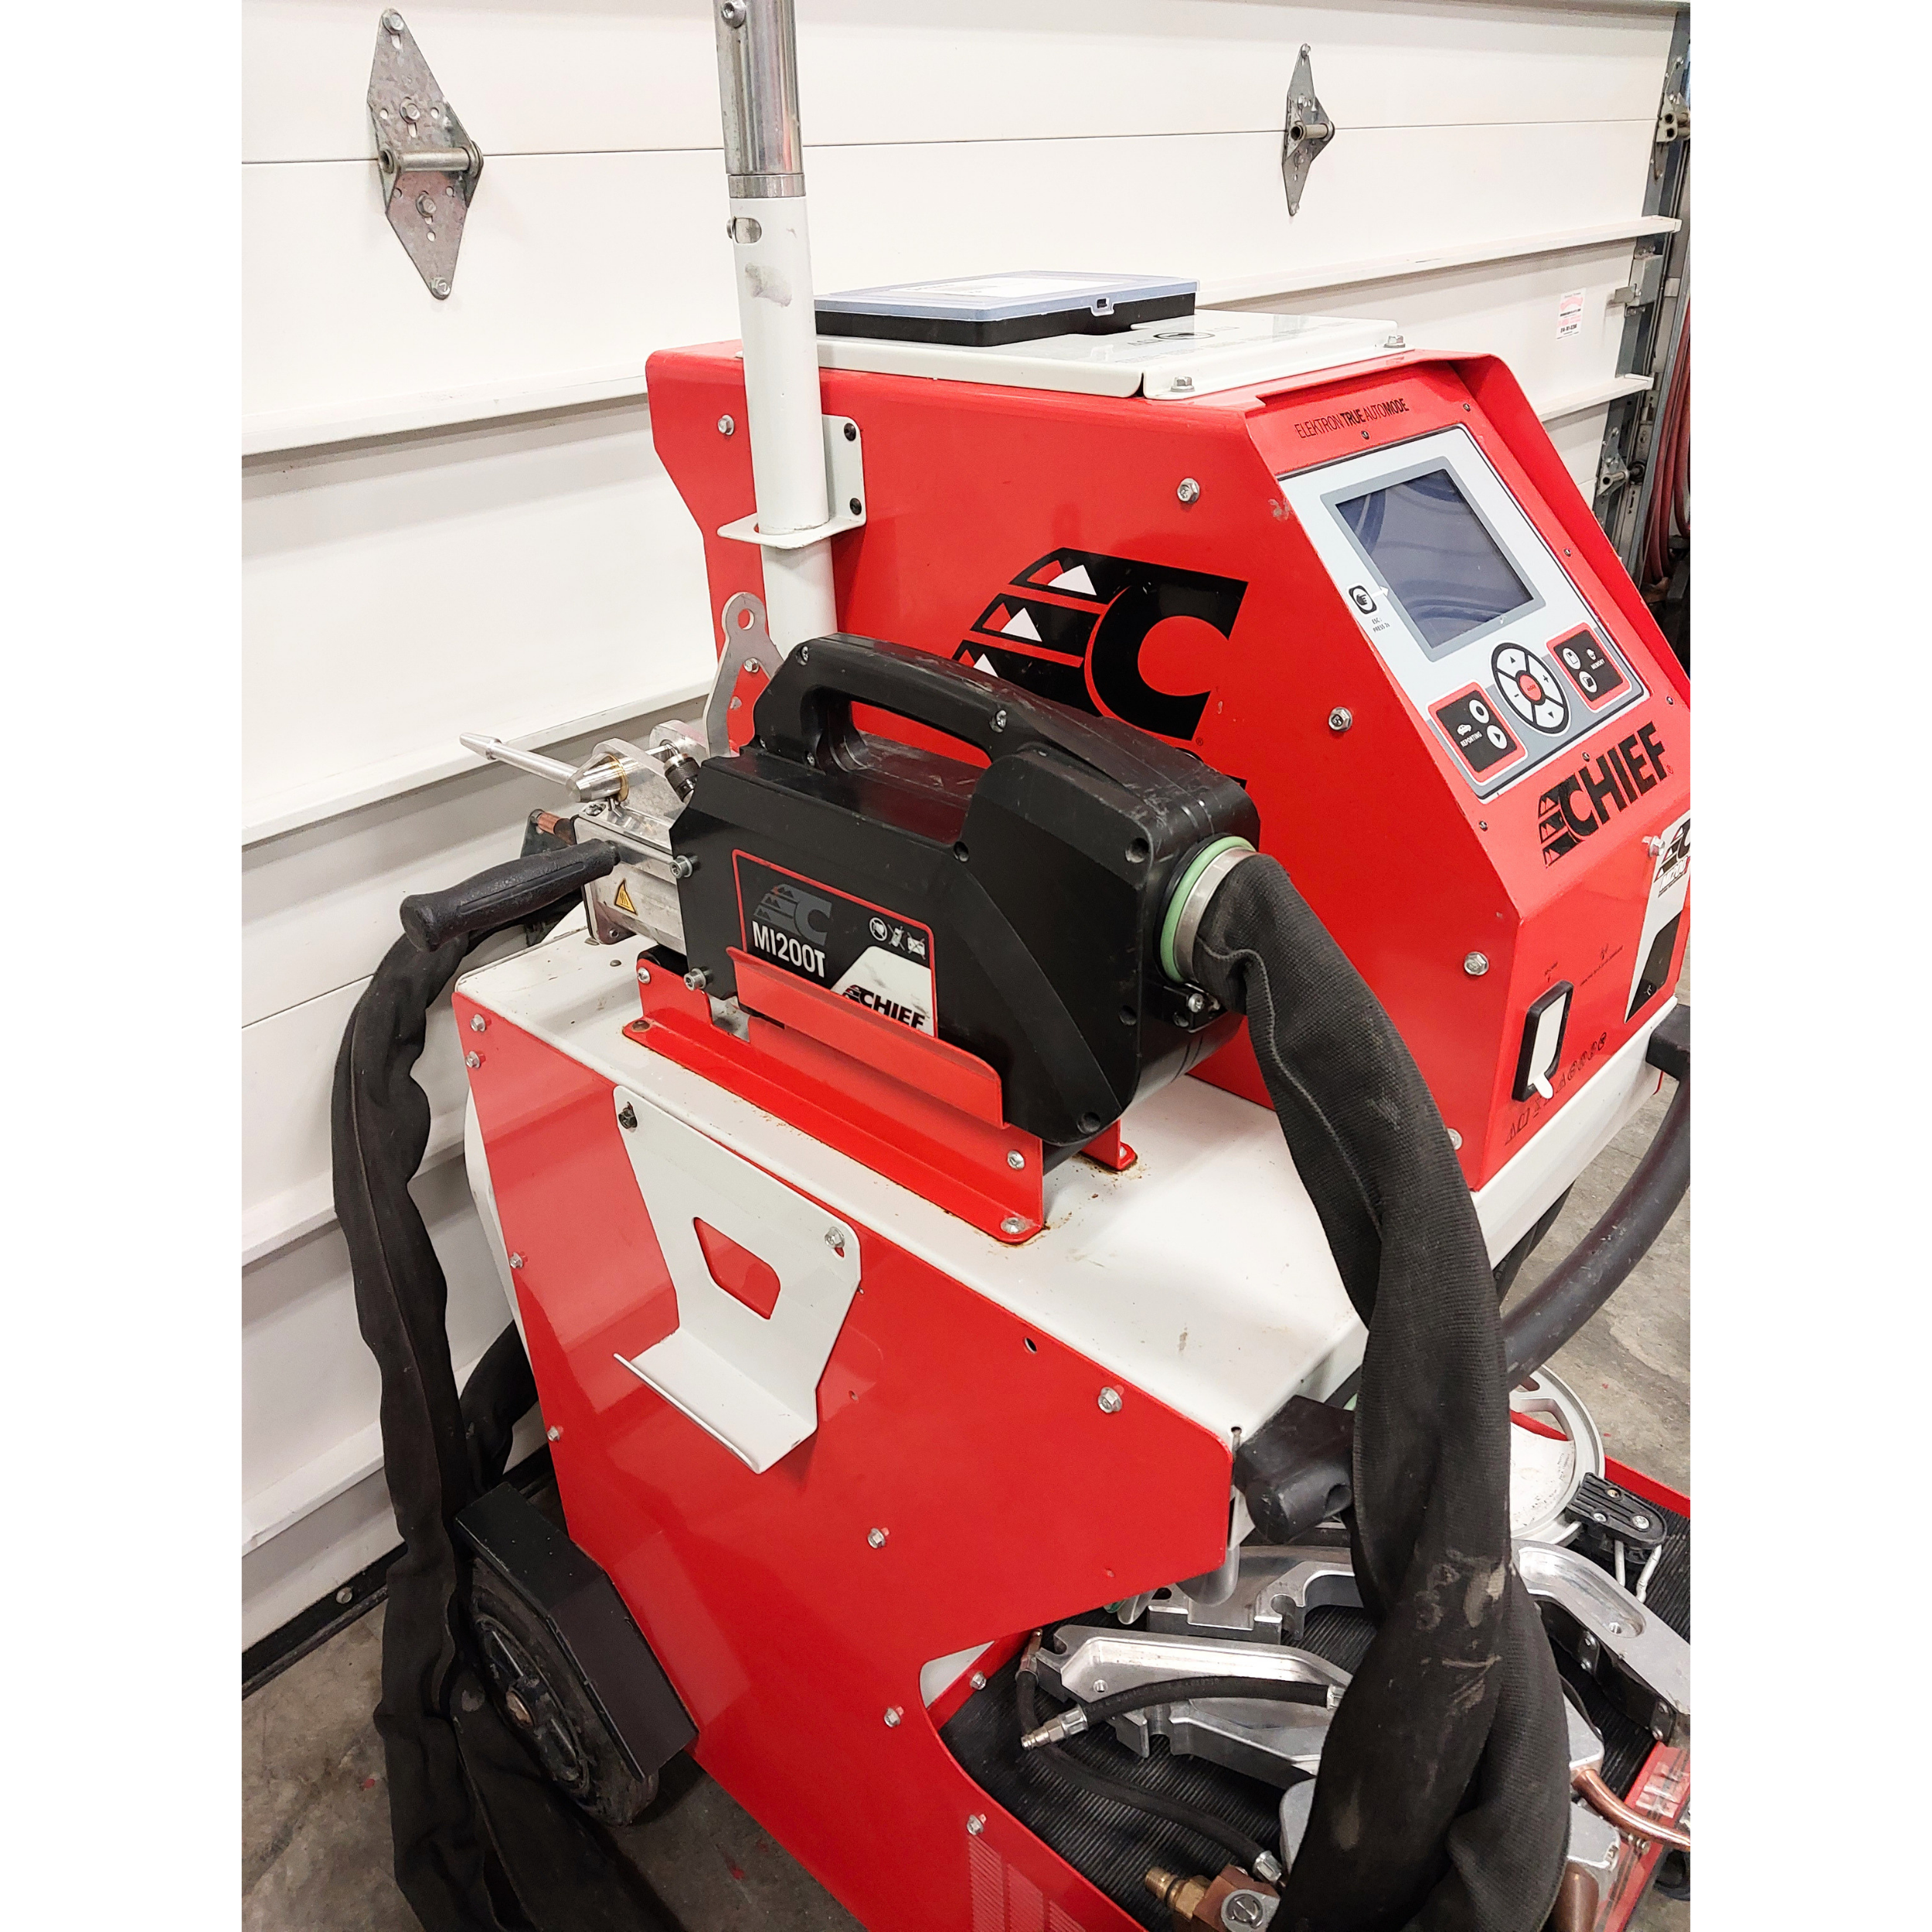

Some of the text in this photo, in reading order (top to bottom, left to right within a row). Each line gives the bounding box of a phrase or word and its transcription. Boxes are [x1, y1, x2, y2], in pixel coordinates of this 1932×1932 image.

[1294, 413, 1345, 438] ELEKTRON
[1340, 409, 1366, 427] TRUE
[1460, 730, 1483, 747] REPORTING
[1558, 720, 1668, 837] CHIEF
[751, 920, 826, 978] MI200T
[859, 990, 926, 1030] CHIEF
